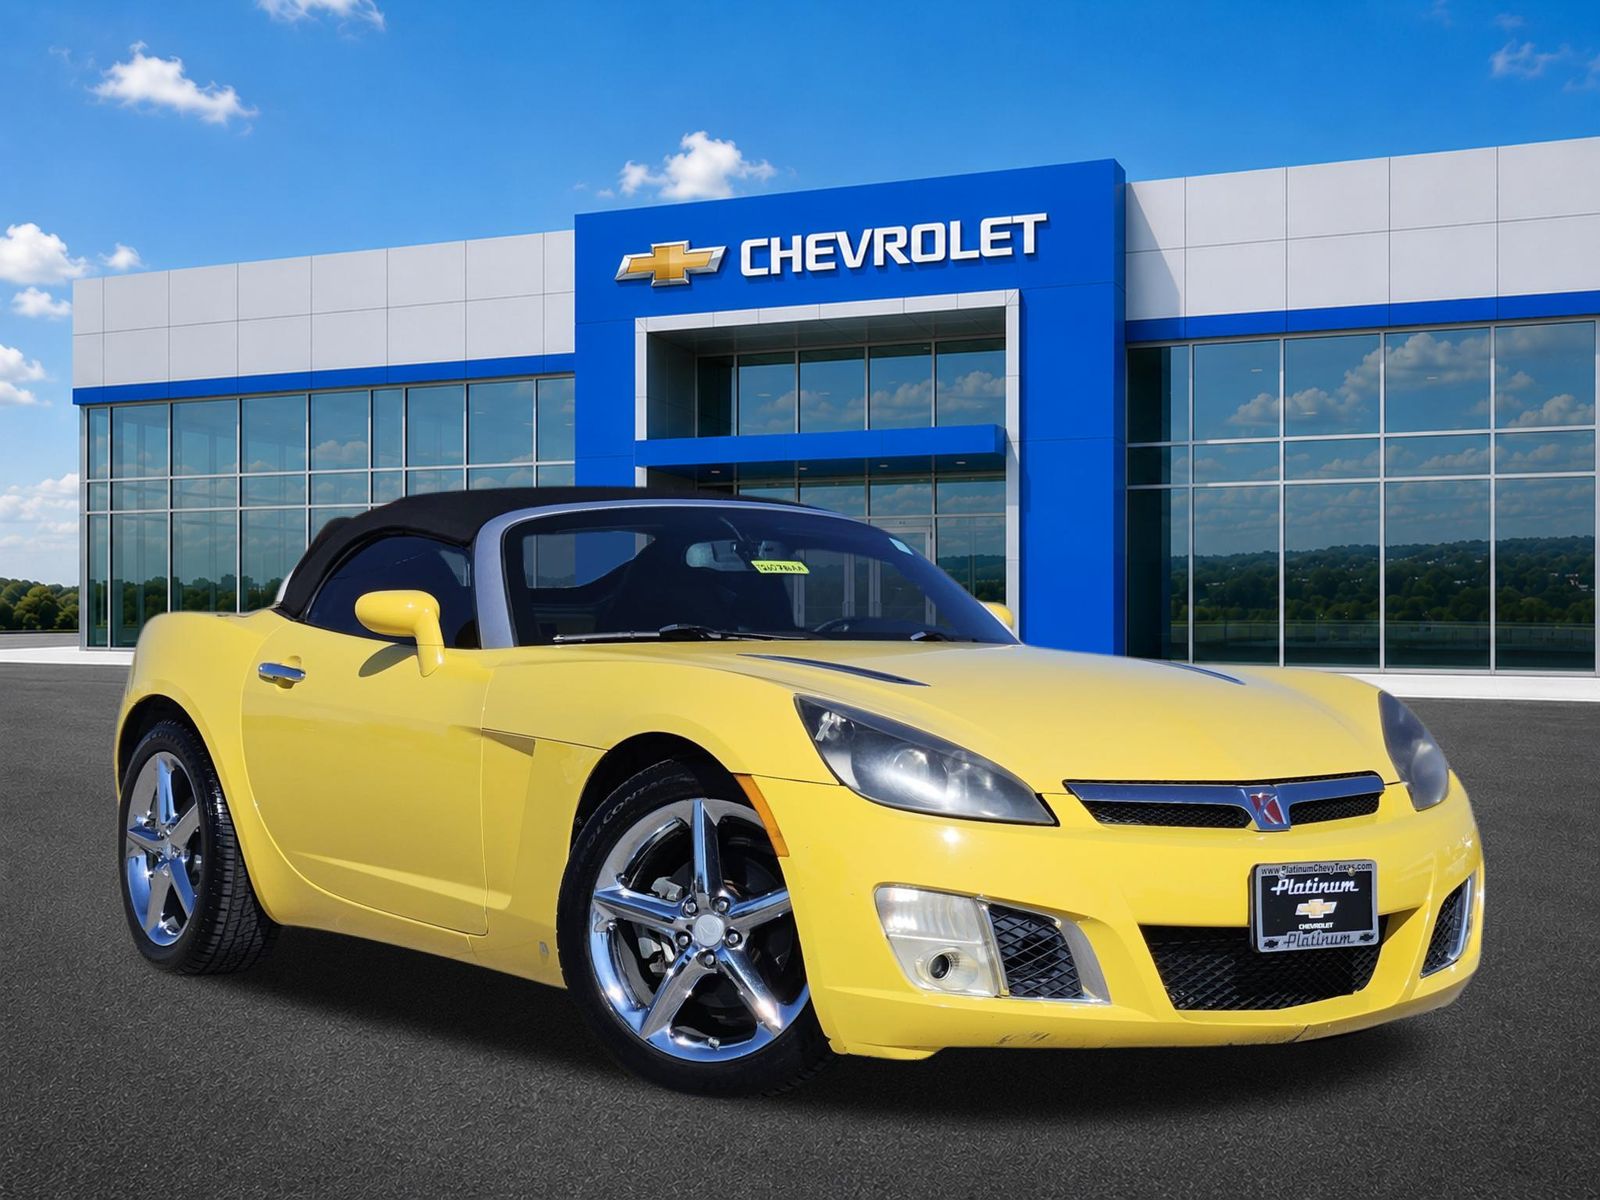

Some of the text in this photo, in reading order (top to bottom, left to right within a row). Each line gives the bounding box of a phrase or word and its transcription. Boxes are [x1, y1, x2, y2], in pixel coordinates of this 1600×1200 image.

[740, 212, 1047, 277] CHEVROLET
[1261, 862, 1373, 875] wwwPlatinumChevyTexas.com
[1270, 877, 1360, 896] Platinum
[1298, 921, 1334, 930] CHEVROLET
[1283, 930, 1355, 948] Platinum
